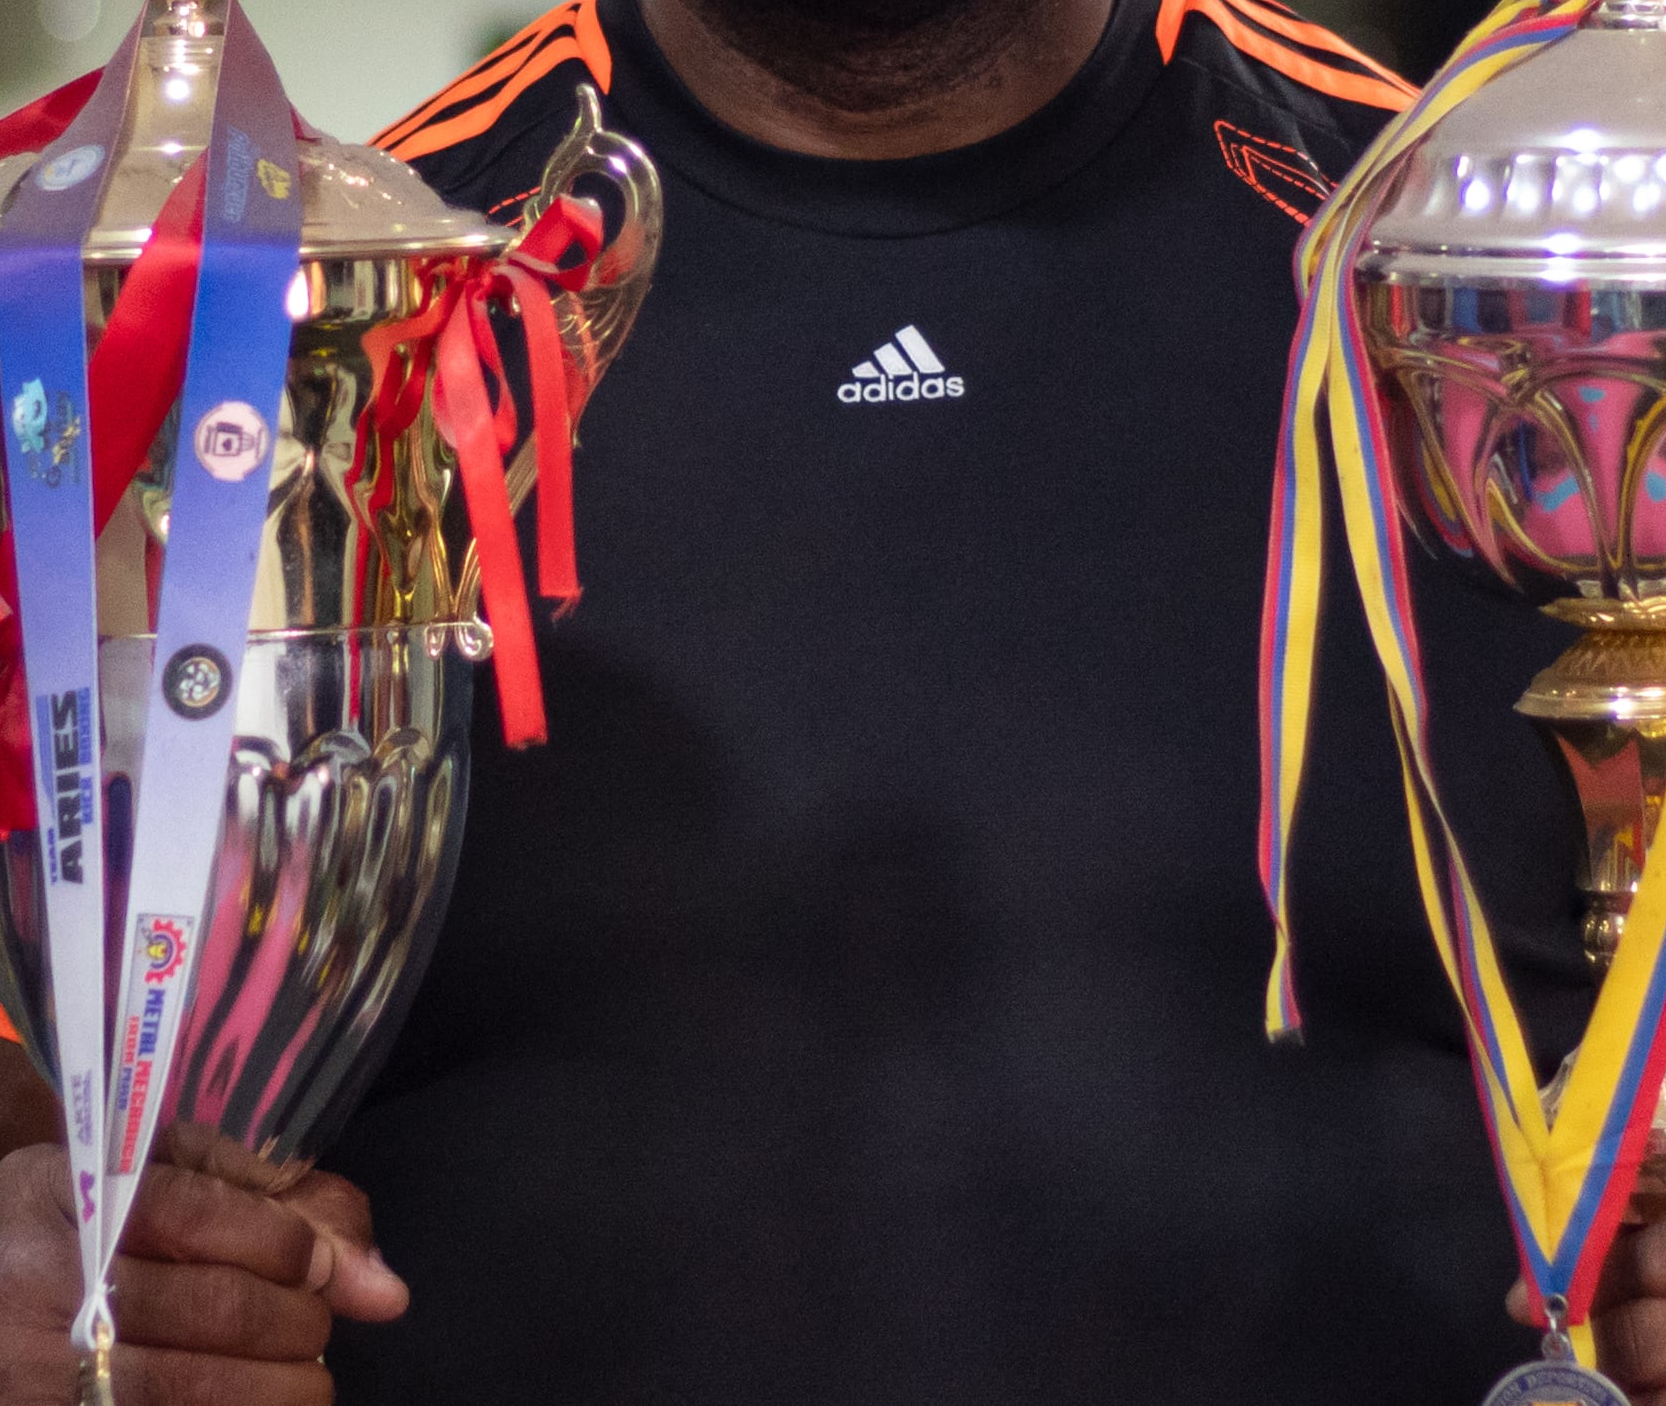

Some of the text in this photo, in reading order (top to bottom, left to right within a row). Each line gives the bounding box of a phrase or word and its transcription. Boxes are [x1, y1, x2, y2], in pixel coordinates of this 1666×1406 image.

[837, 373, 965, 403] adidas
[52, 690, 83, 884] ARIES
[139, 989, 165, 1056] METAL
